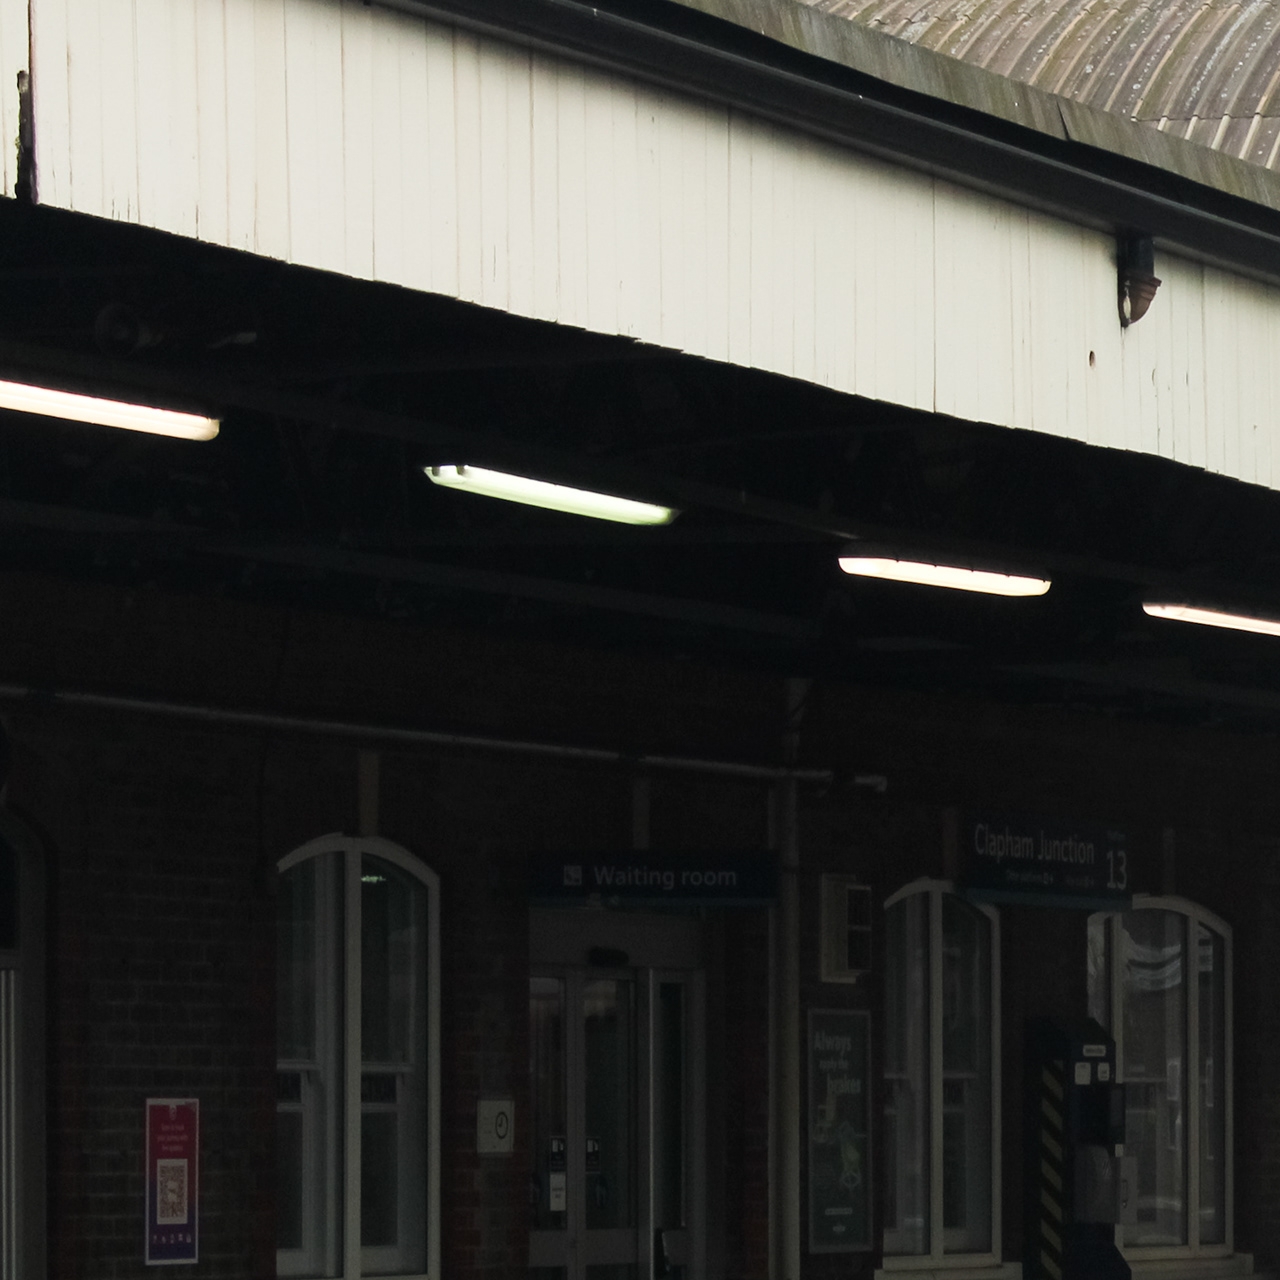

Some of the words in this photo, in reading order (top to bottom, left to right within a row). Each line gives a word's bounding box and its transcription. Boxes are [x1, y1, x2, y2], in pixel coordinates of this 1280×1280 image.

[975, 823, 1034, 864] Clapham
[1037, 829, 1095, 865] Junction
[594, 866, 675, 890] Waiting
[682, 871, 737, 886] room
[1106, 850, 1128, 890] 13
[814, 1031, 852, 1057] Always
